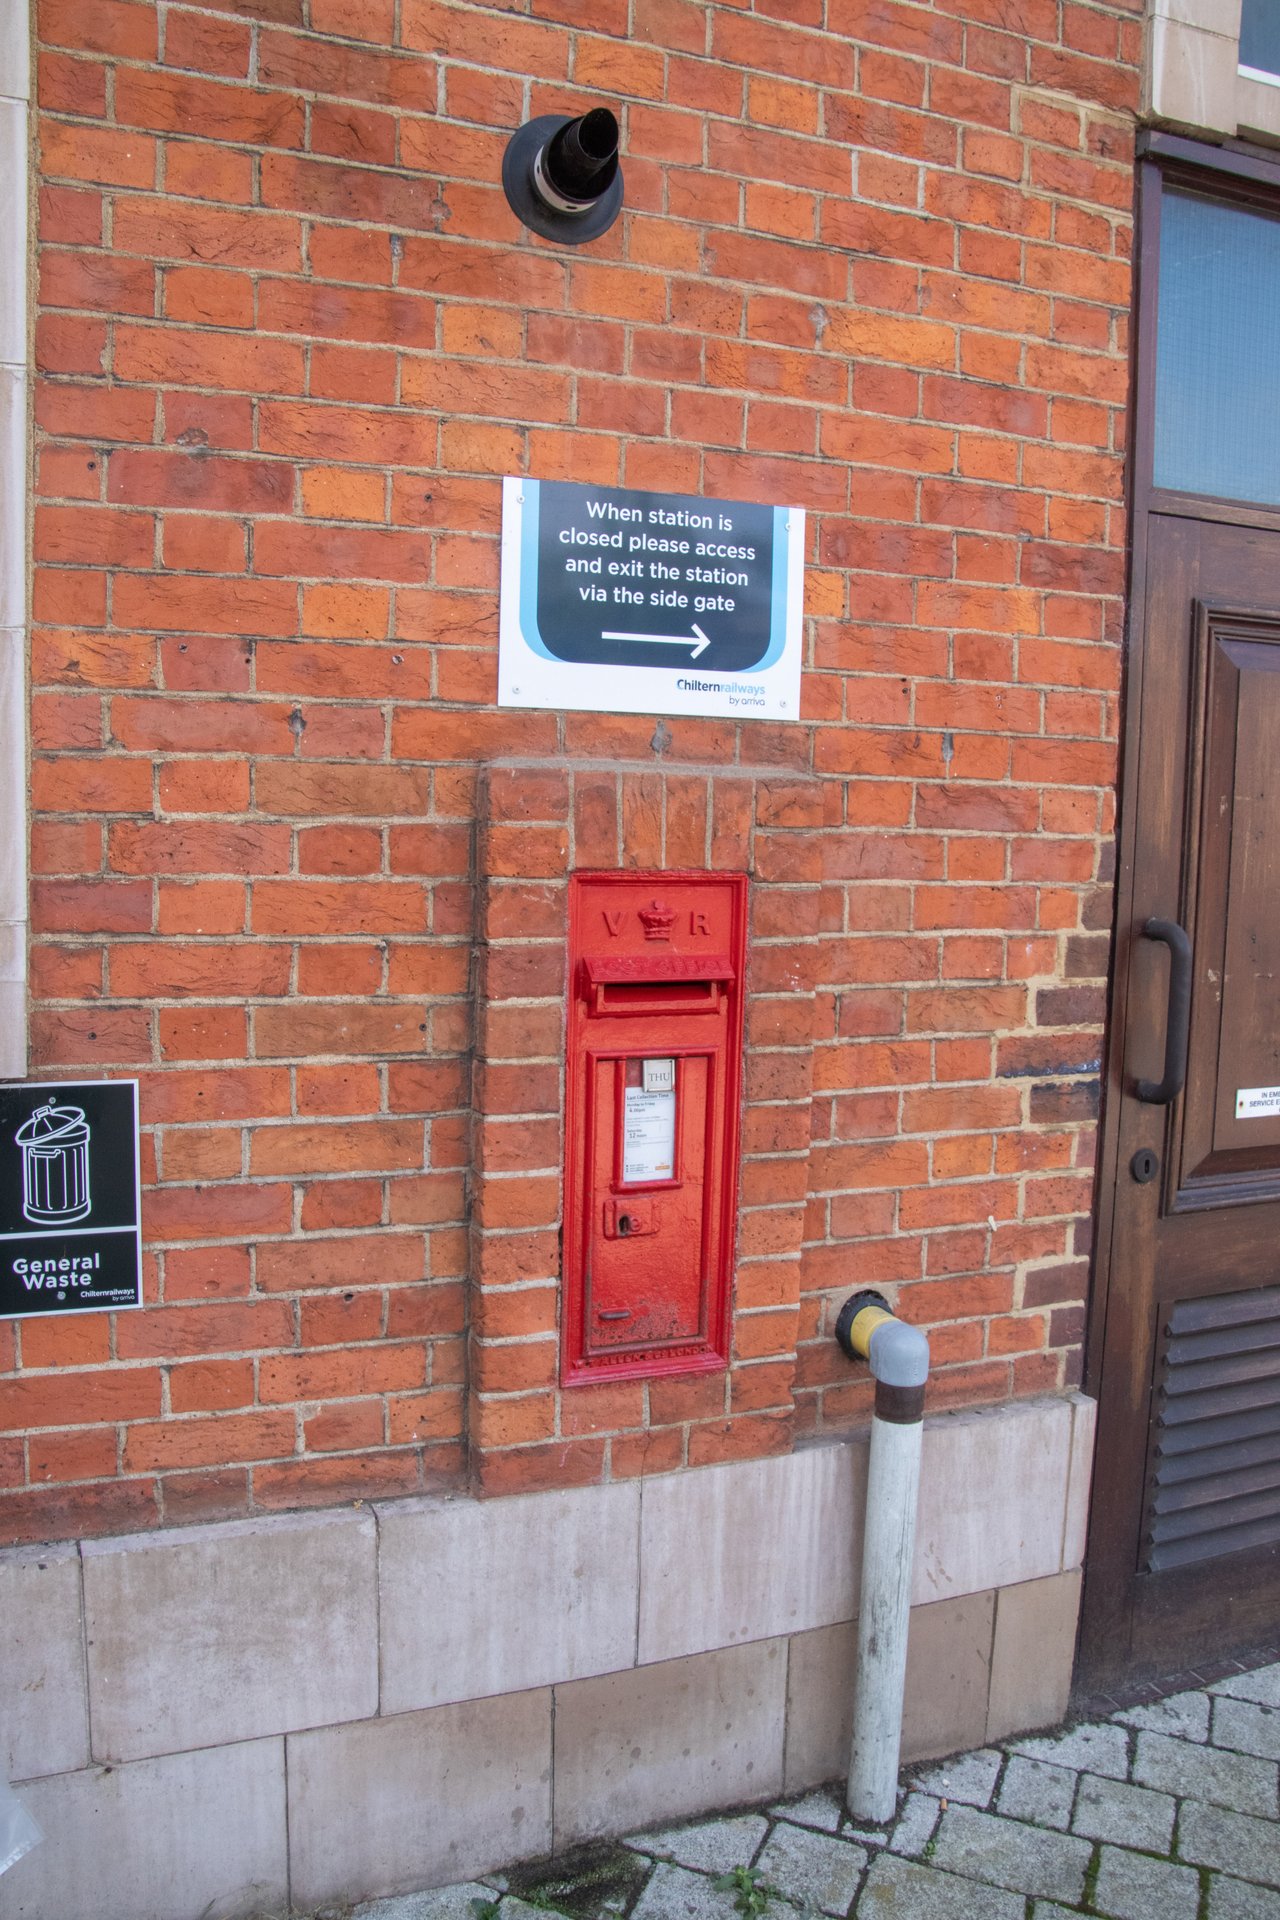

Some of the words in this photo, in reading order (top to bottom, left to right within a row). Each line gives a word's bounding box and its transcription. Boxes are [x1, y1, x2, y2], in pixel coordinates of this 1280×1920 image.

[586, 500, 643, 523] When
[649, 508, 713, 530] station
[718, 514, 733, 532] is
[559, 527, 623, 549] closed
[629, 533, 690, 554] please
[695, 541, 756, 561] access
[565, 556, 602, 574] and
[608, 559, 644, 578] exit
[650, 562, 680, 580] the
[686, 566, 749, 587] station
[579, 584, 608, 602] via
[613, 586, 644, 605] the
[650, 589, 689, 608] side
[694, 593, 736, 612] gate
[676, 678, 766, 696] Chilternrailways
[729, 695, 739, 706] by
[741, 695, 766, 706] arriva
[689, 911, 711, 936] R
[649, 1073, 670, 1082] THU
[1249, 1099, 1274, 1107] SERVICE
[12, 1253, 100, 1274] General
[22, 1272, 92, 1290] Waste
[80, 1288, 135, 1298] Chilternrailways
